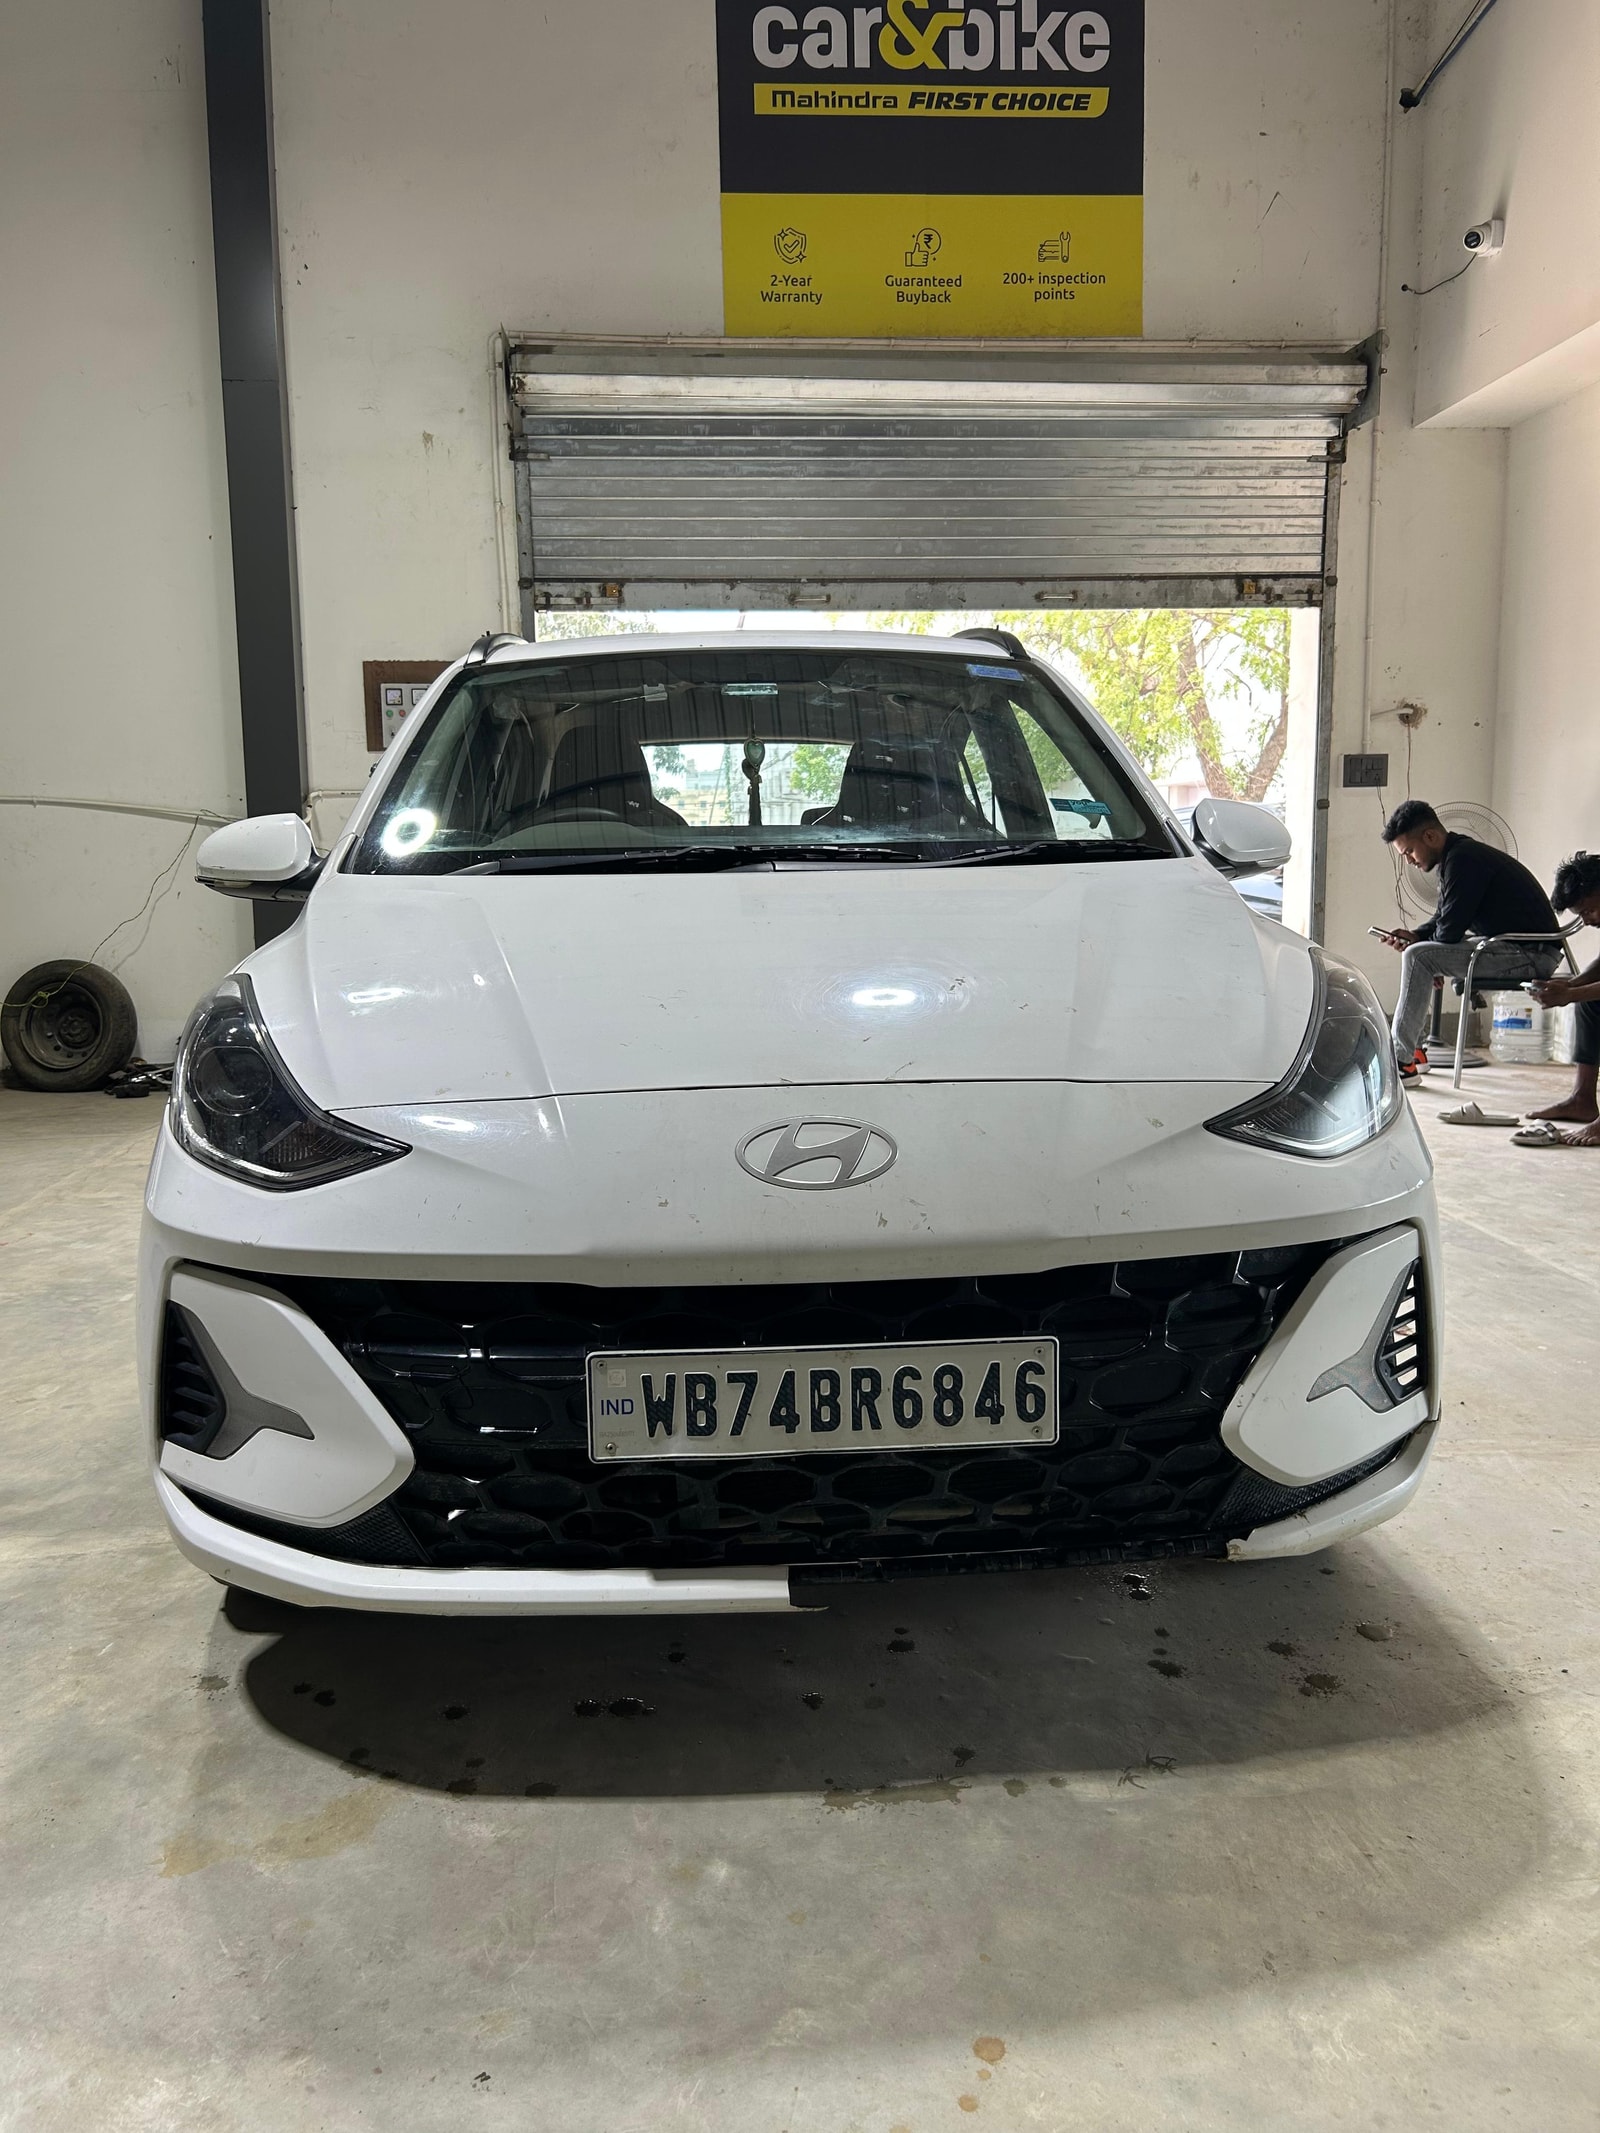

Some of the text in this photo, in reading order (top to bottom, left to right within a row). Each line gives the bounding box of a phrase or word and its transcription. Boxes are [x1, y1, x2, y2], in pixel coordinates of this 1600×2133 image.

[752, 0, 1111, 73] car&bike
[771, 90, 1092, 111] Mahindra FIRST CHOICE
[770, 274, 813, 288] 2-Year
[884, 275, 963, 288] Guaranteed
[1002, 272, 1106, 288] 200+ inspection
[760, 290, 823, 306] Warranty
[896, 290, 952, 306] Buyback
[1034, 287, 1076, 302] points
[600, 1360, 1047, 1439] IND WB74BR6846
